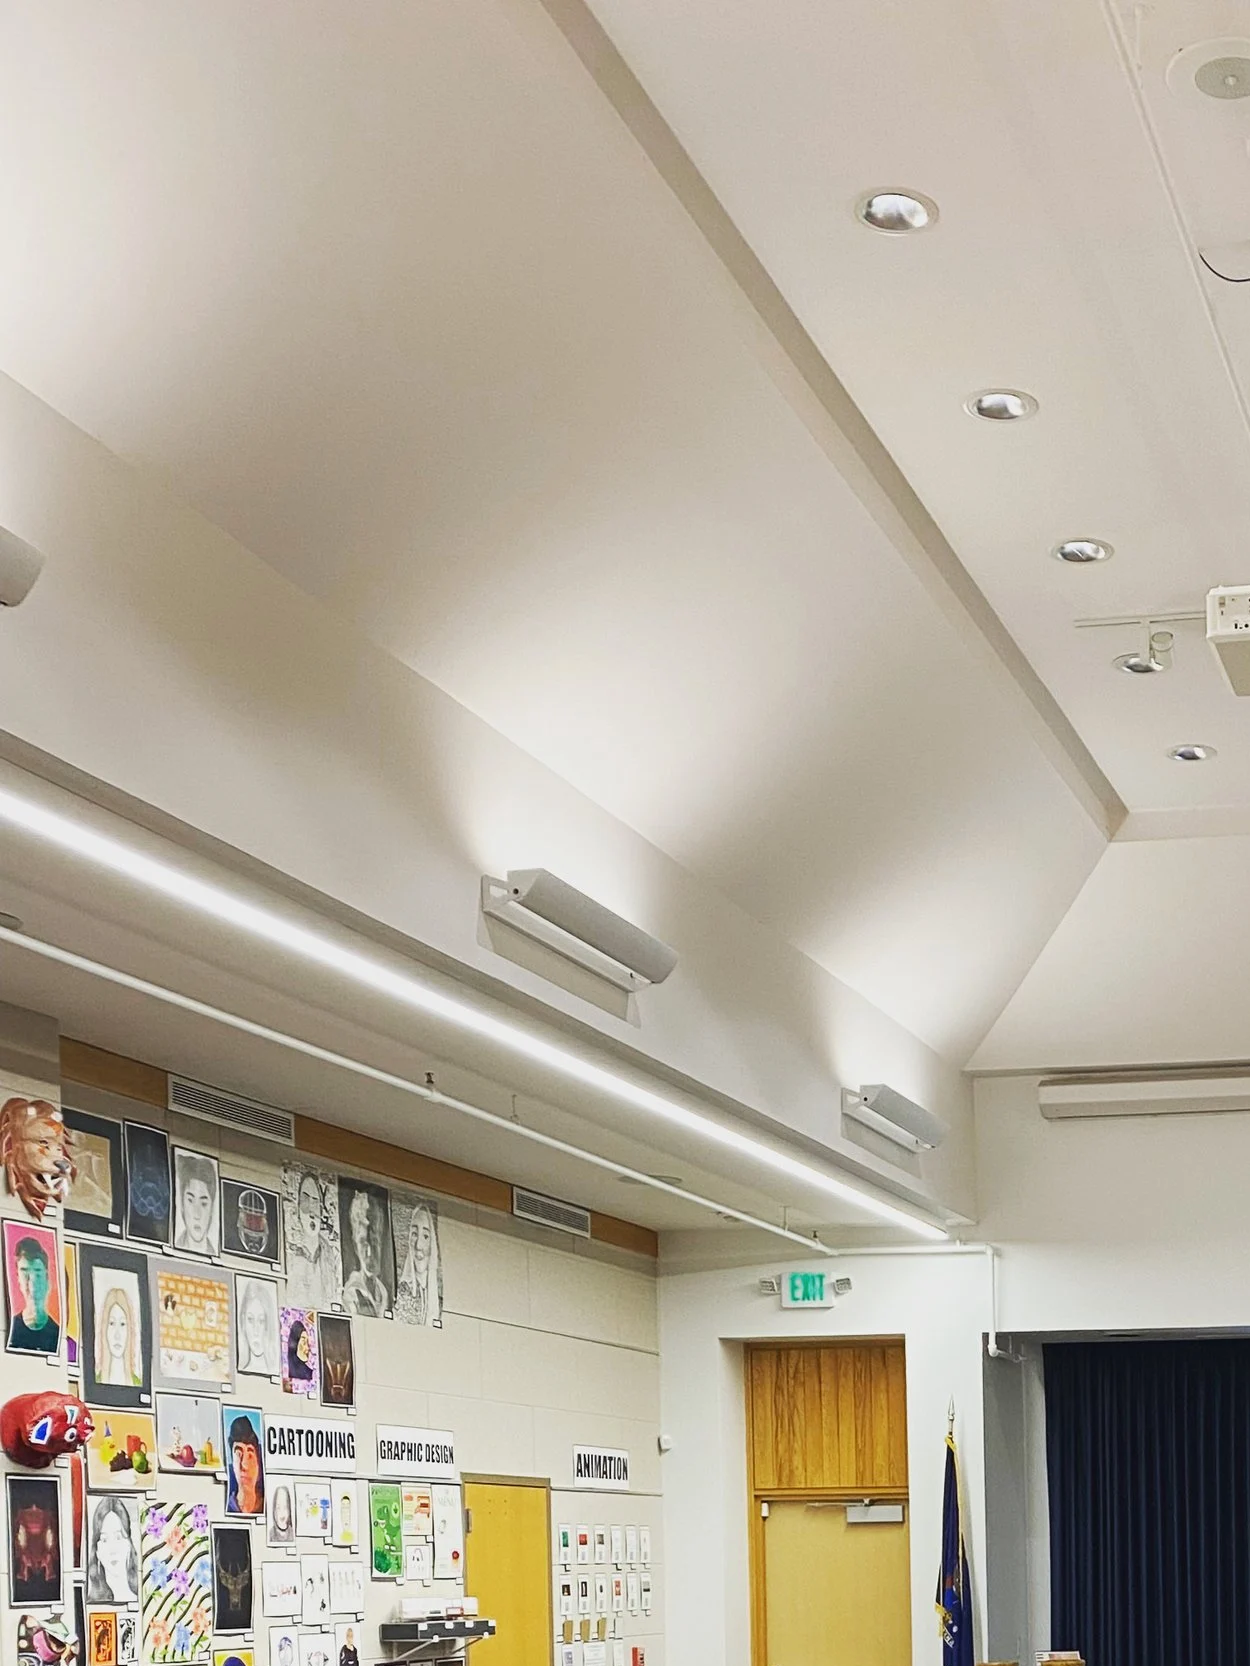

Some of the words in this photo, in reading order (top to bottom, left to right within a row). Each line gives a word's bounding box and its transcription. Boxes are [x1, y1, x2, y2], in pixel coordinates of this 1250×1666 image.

[790, 1273, 825, 1301] EXIT
[267, 1426, 355, 1460] CARTOONING
[379, 1440, 423, 1463] GRAPHIC
[425, 1444, 454, 1465] DESIGN
[576, 1453, 628, 1481] ANIMATION
